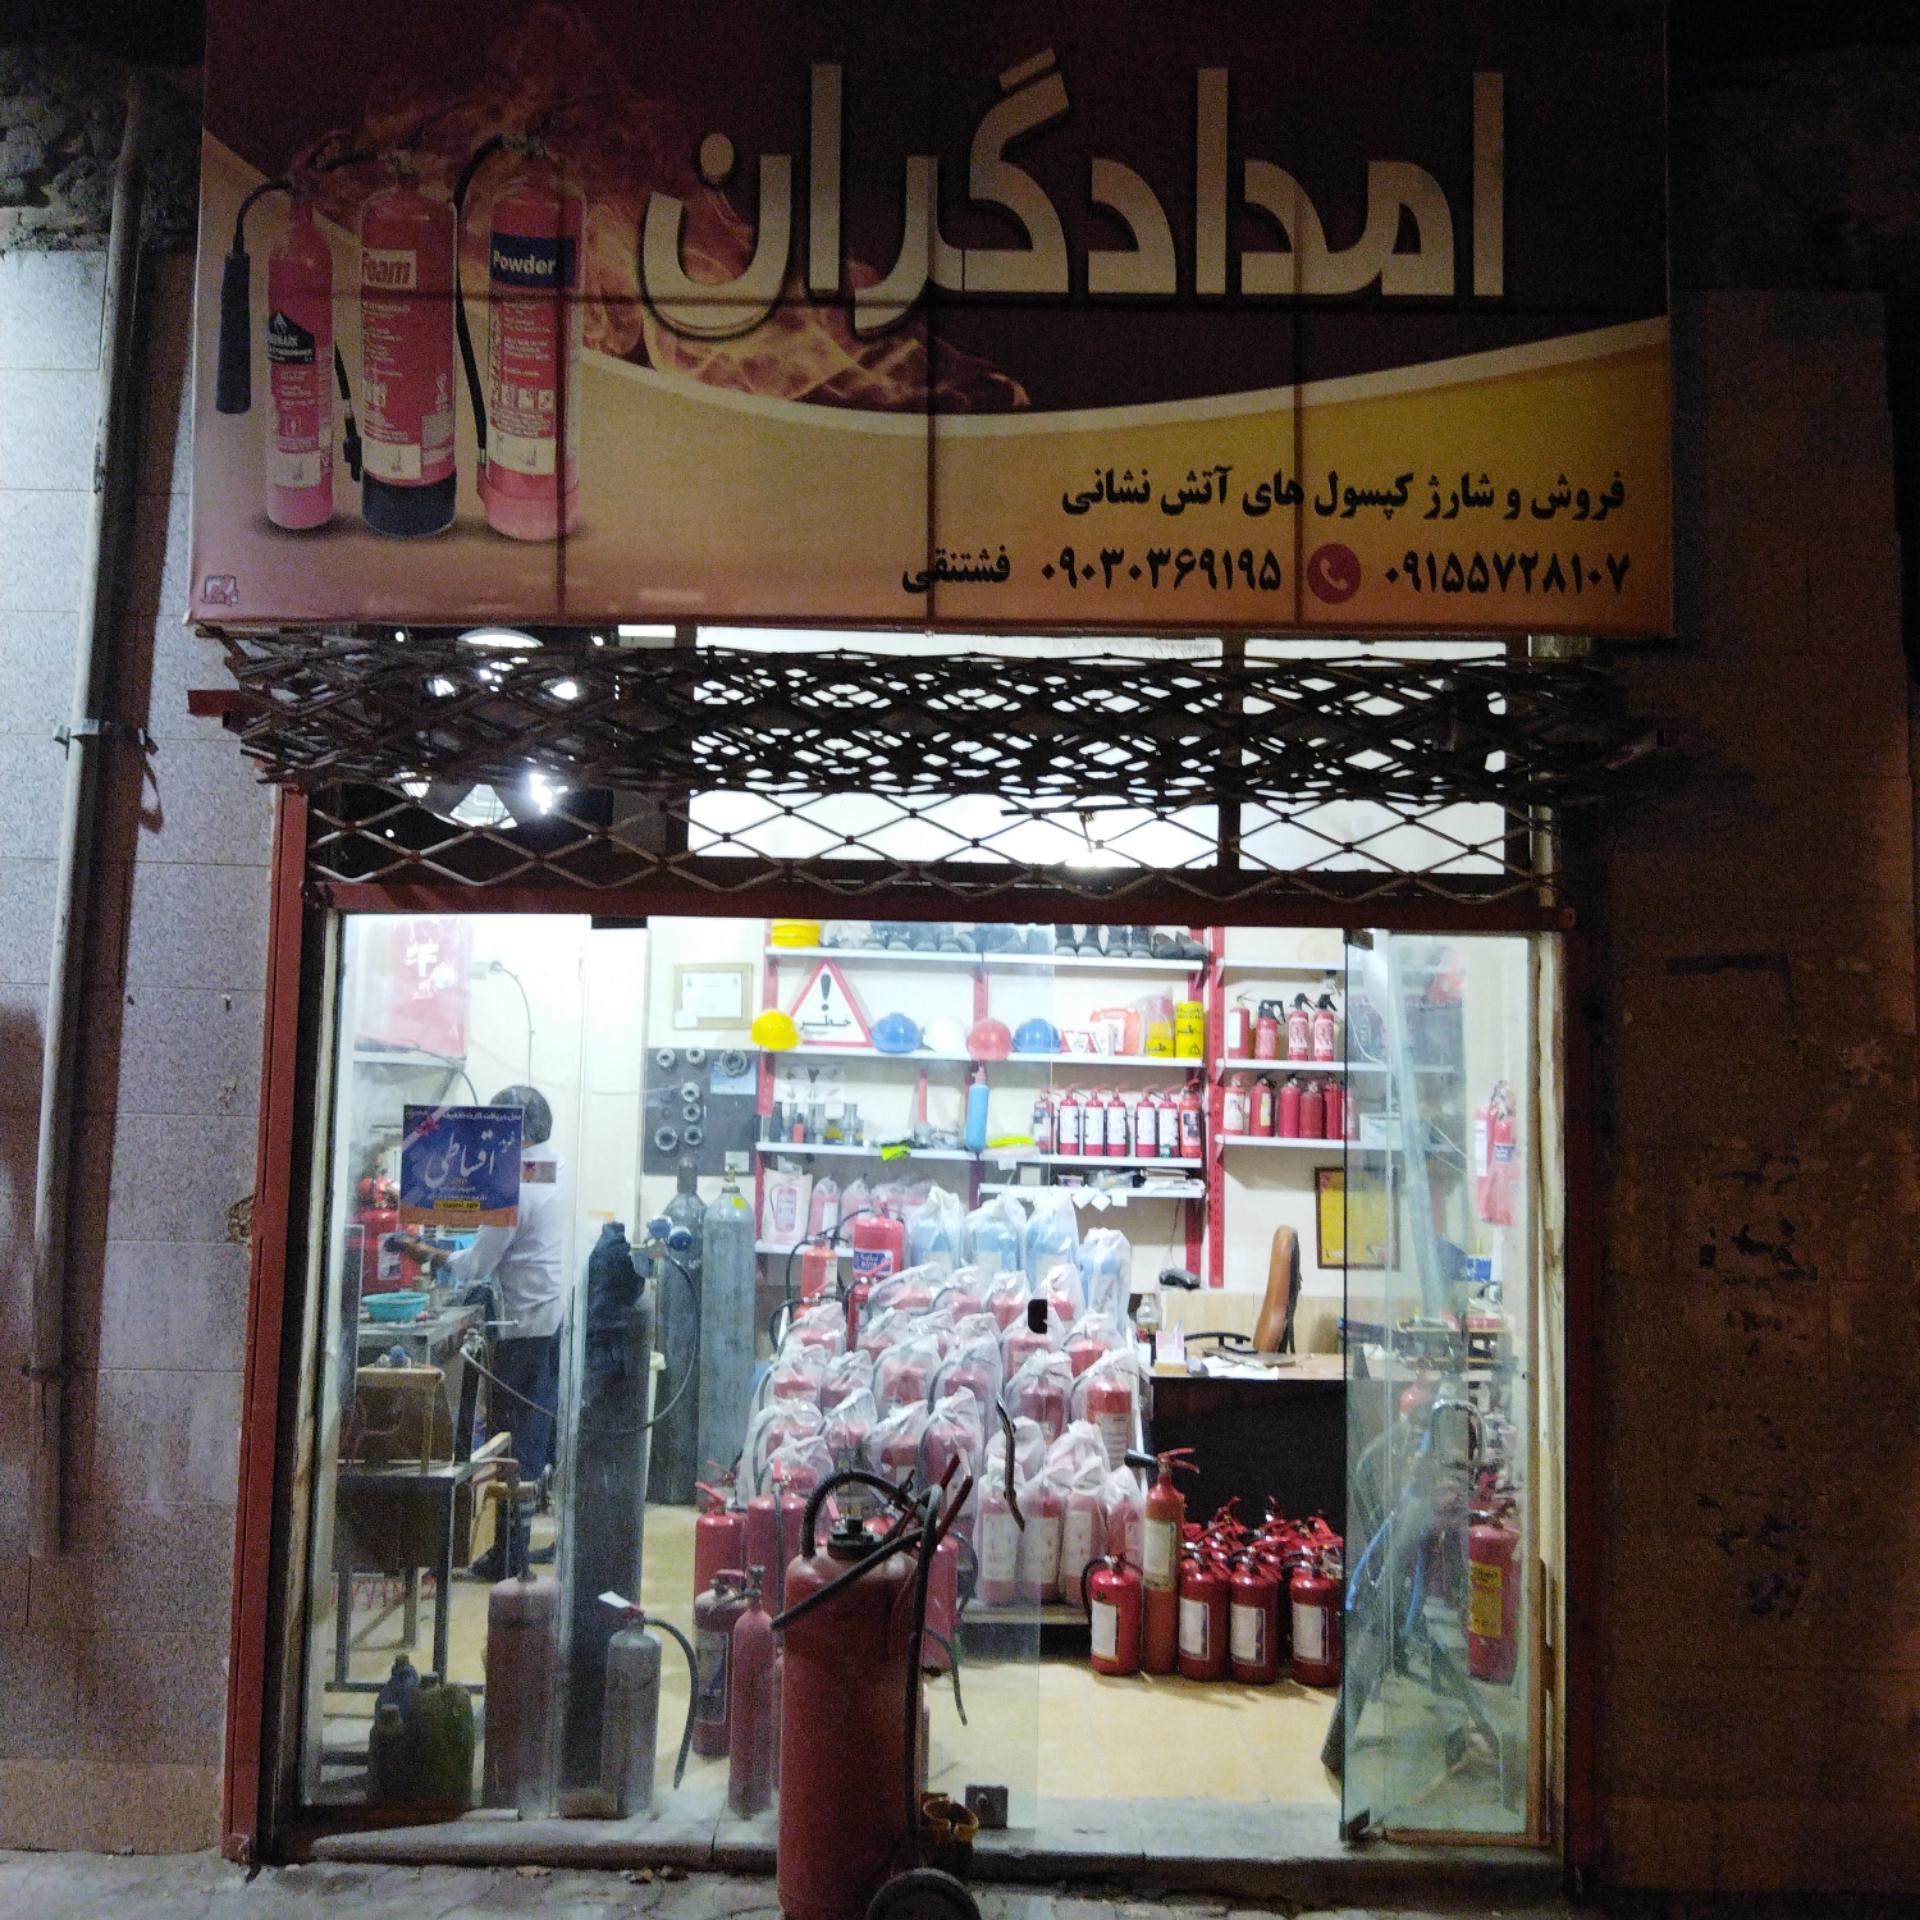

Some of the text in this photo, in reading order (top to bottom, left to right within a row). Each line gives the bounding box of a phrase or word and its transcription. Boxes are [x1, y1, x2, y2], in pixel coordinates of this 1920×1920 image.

[643, 47, 1505, 332] امدادگران
[493, 249, 556, 275] Powder
[1062, 465, 1626, 521] فروش و شارژ کپسول های آتش نشانی
[902, 544, 1631, 594] ۰۹۱۵۵۷۲۸۱۰۷ ۰۹۰۳۰۳۶۹۱۹۵ فشتنقی
